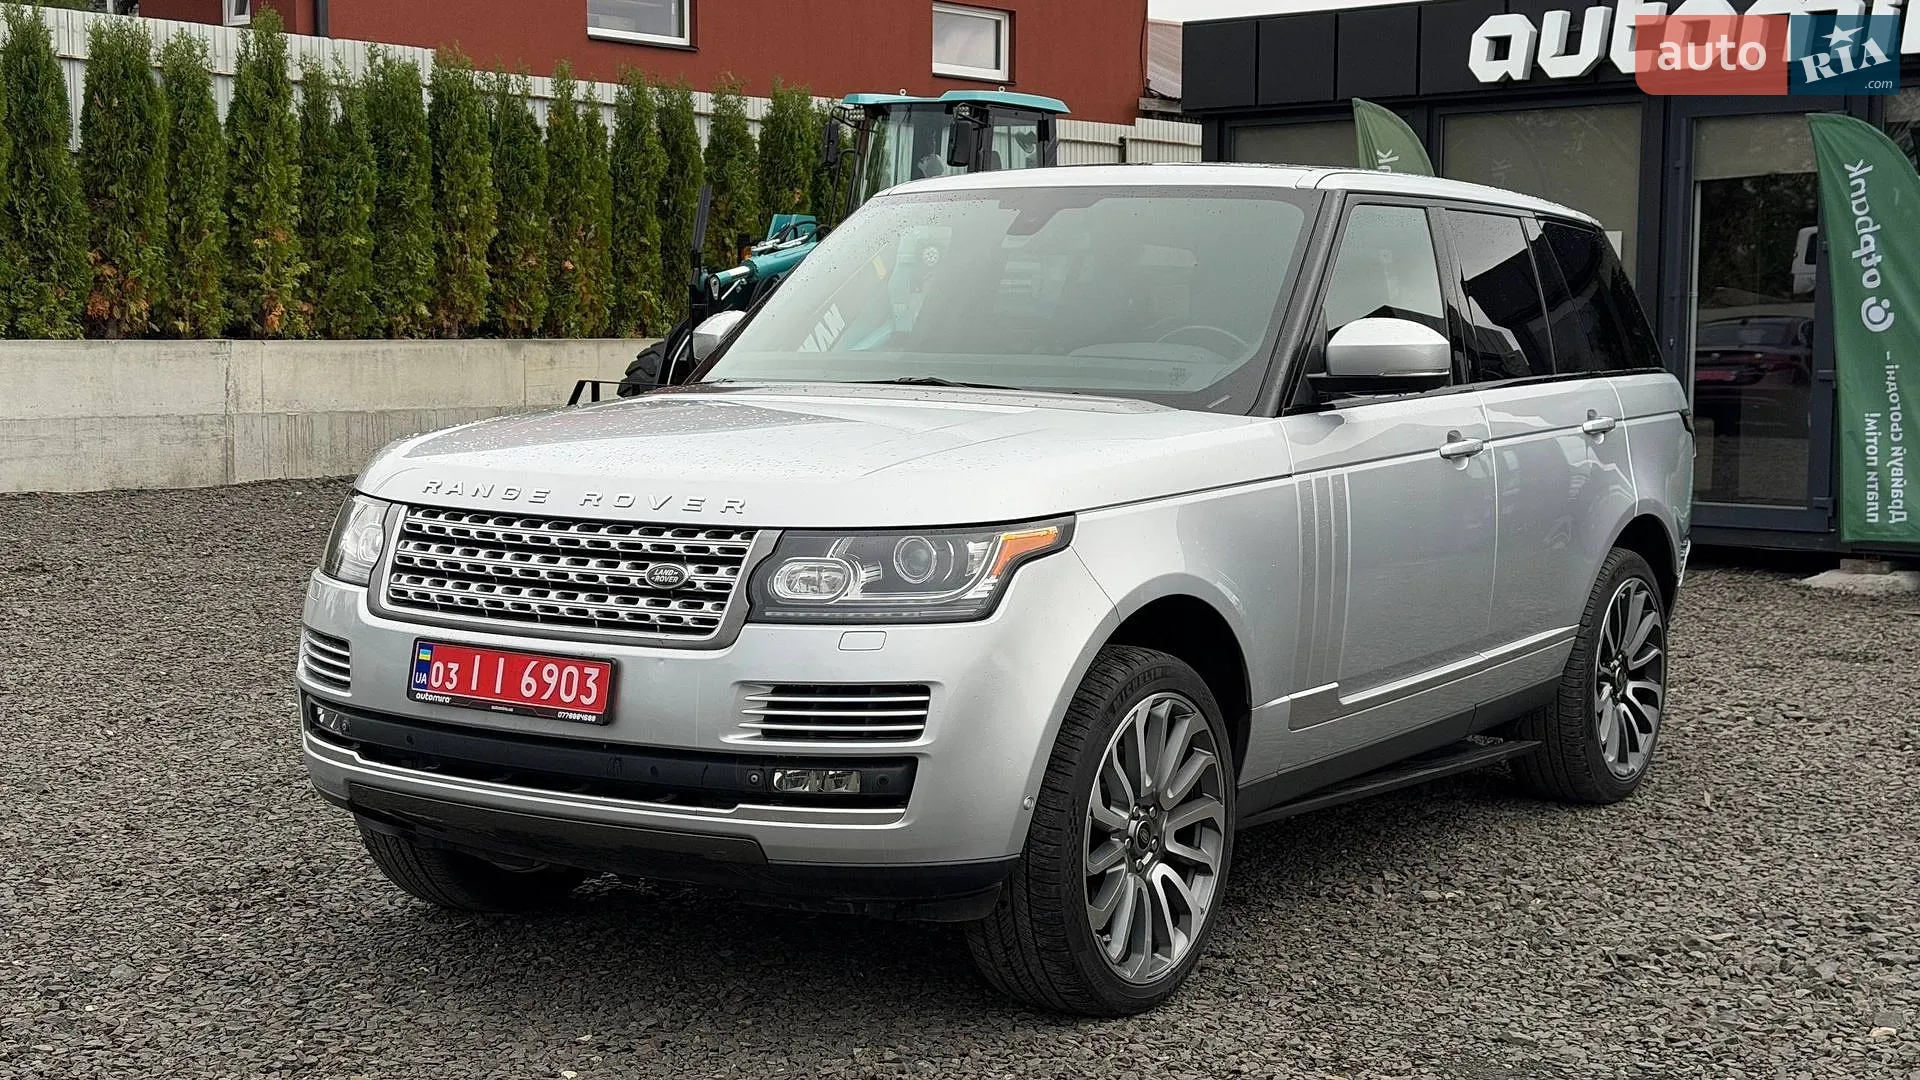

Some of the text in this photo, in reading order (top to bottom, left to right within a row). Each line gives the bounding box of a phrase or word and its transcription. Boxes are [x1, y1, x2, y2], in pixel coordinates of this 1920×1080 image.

[421, 479, 748, 515] RANGE ROVER
[653, 568, 675, 576] LAND
[654, 575, 679, 583] ROVER
[415, 671, 427, 685] UA
[430, 661, 460, 690] 03
[520, 660, 600, 705] 6903
